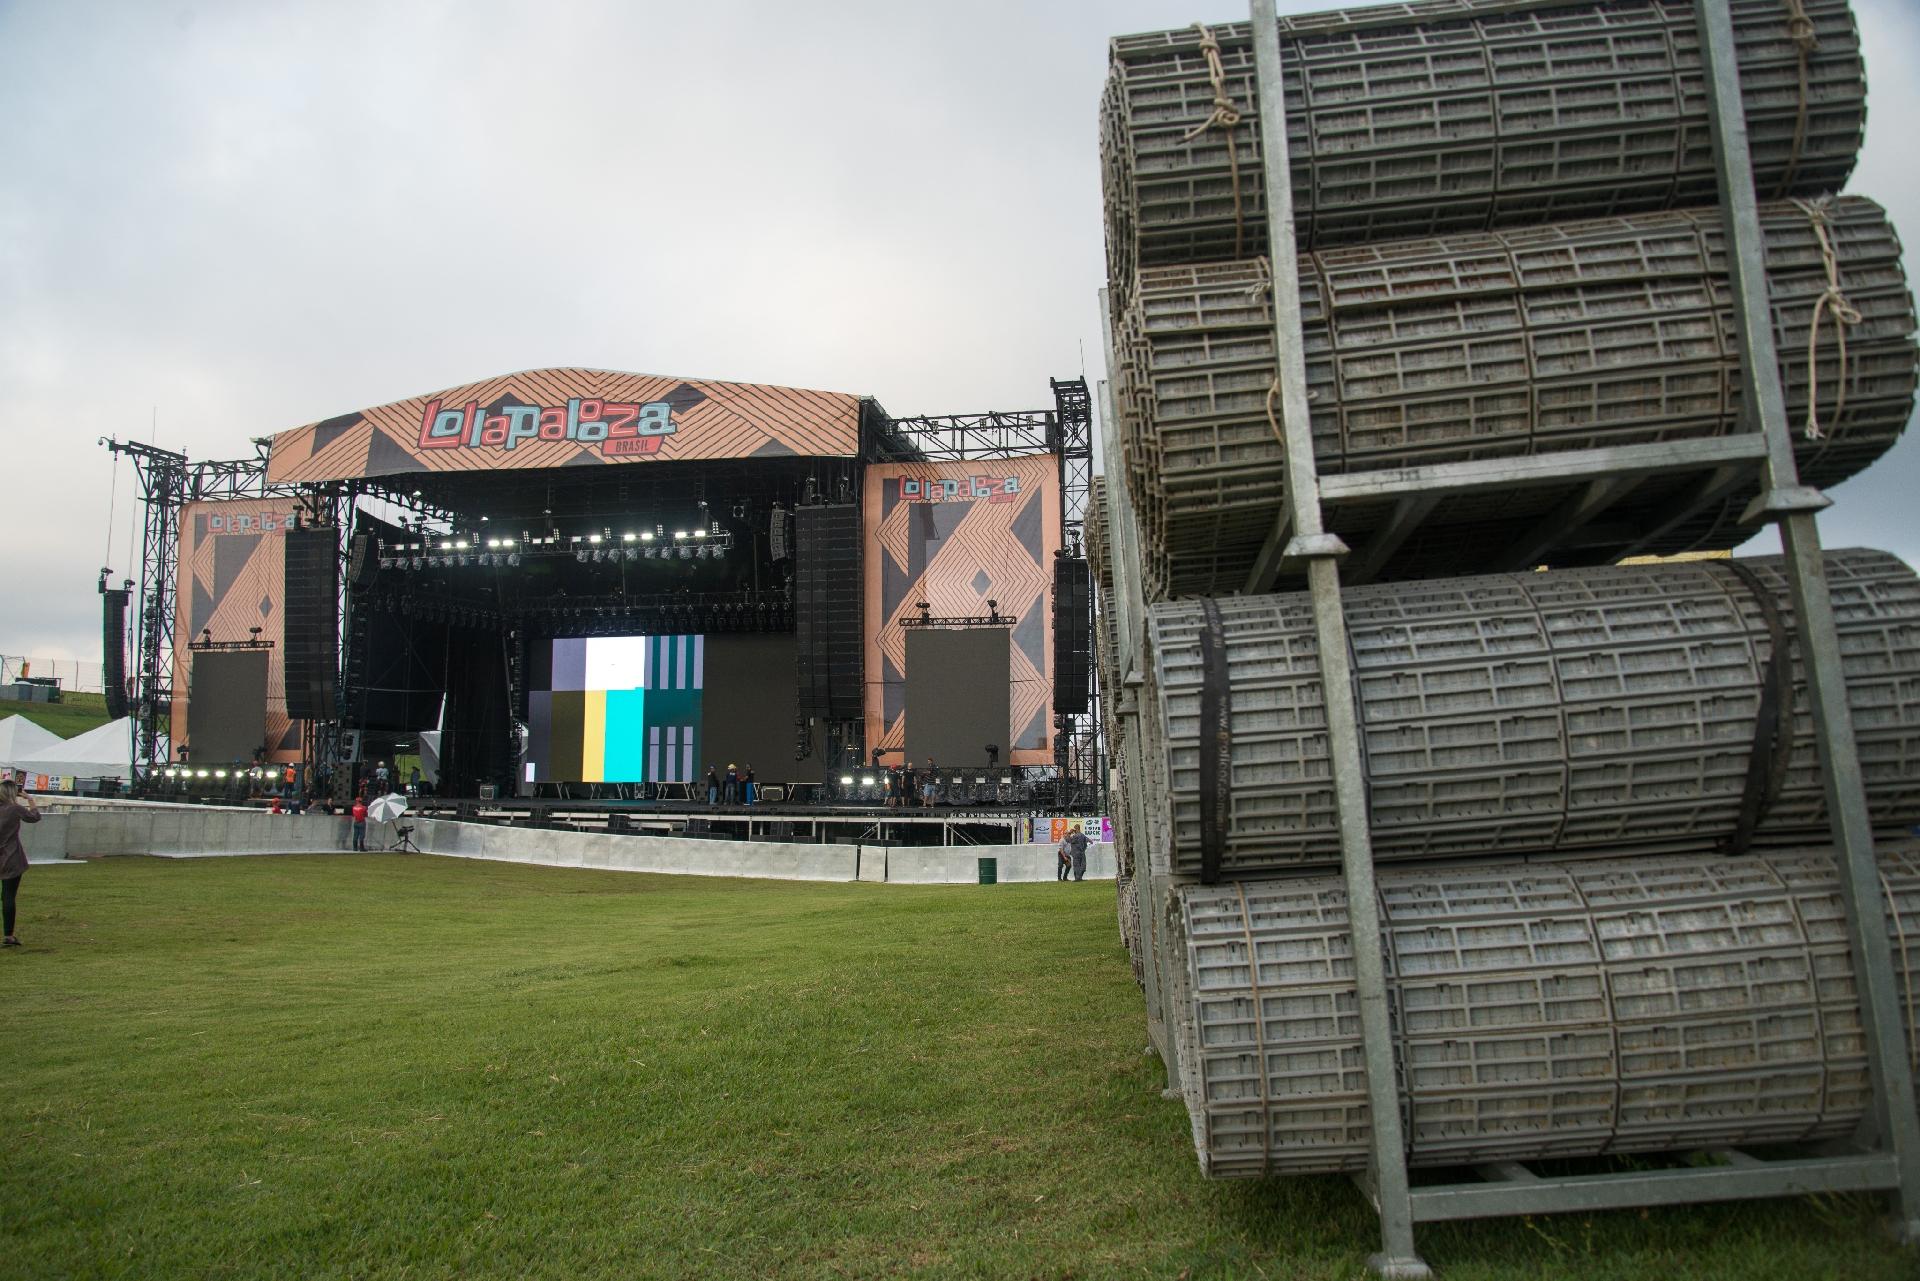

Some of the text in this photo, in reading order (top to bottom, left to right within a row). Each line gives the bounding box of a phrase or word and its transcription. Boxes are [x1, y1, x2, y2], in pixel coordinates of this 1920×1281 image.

[418, 398, 678, 450] Lollapalooza
[615, 439, 649, 453] BRASIL
[899, 475, 1022, 502] Lollapalooza
